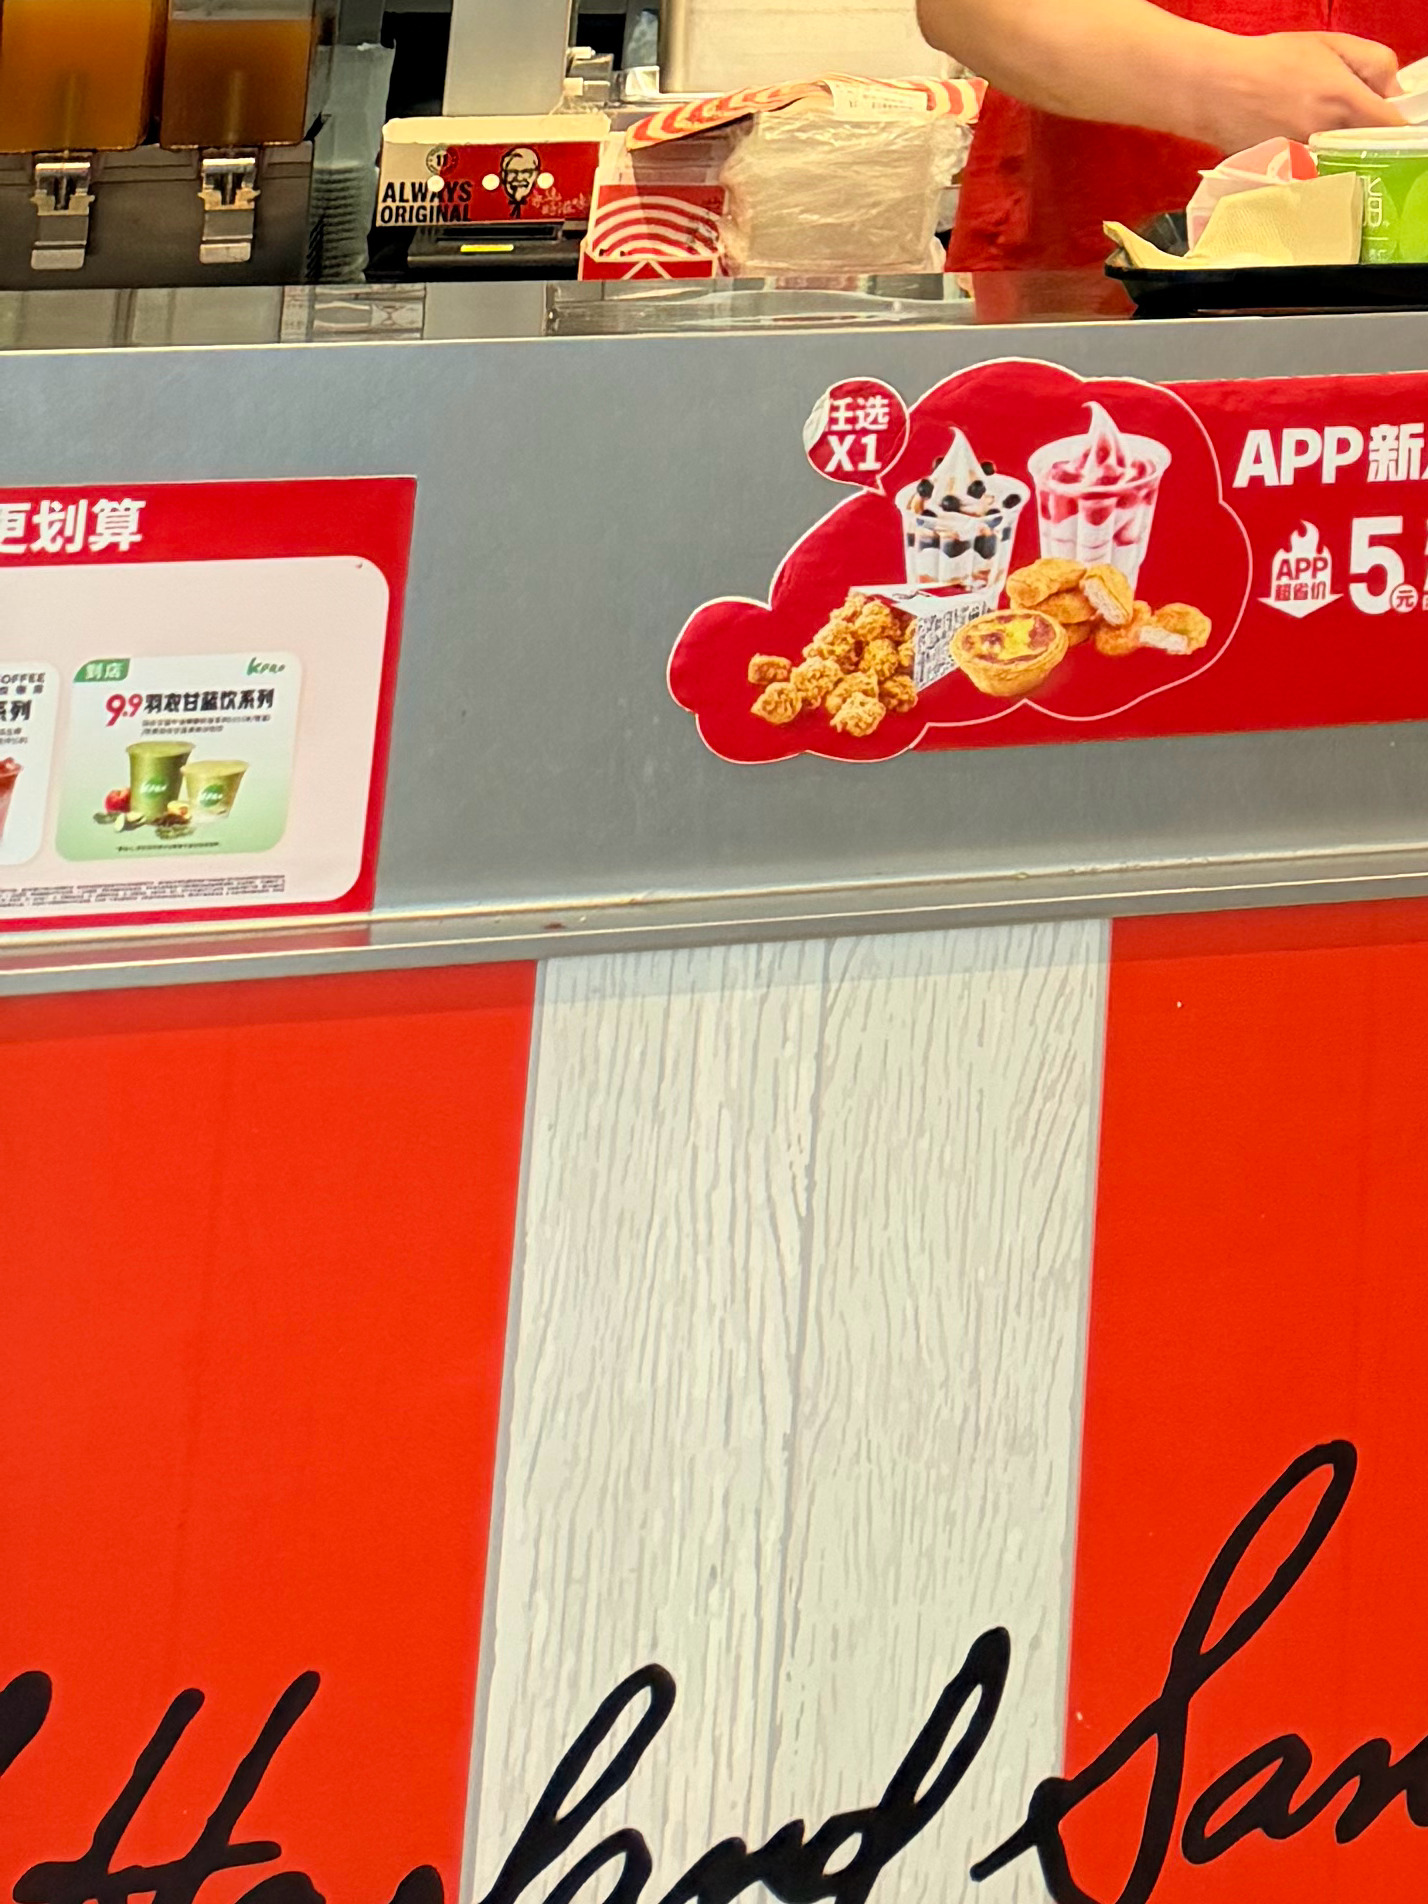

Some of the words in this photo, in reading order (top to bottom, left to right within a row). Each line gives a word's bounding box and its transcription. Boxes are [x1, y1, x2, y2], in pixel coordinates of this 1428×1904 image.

[382, 180, 473, 203] ALWAYS
[381, 204, 472, 223] ORIGINAL
[824, 435, 882, 473] X1
[1276, 557, 1328, 581] APP
[1348, 515, 1404, 615] 5
[0, 672, 45, 684] OFFEE
[105, 694, 143, 727] 9.9
[143, 688, 275, 714] 羽衣甘蓝饮系列
